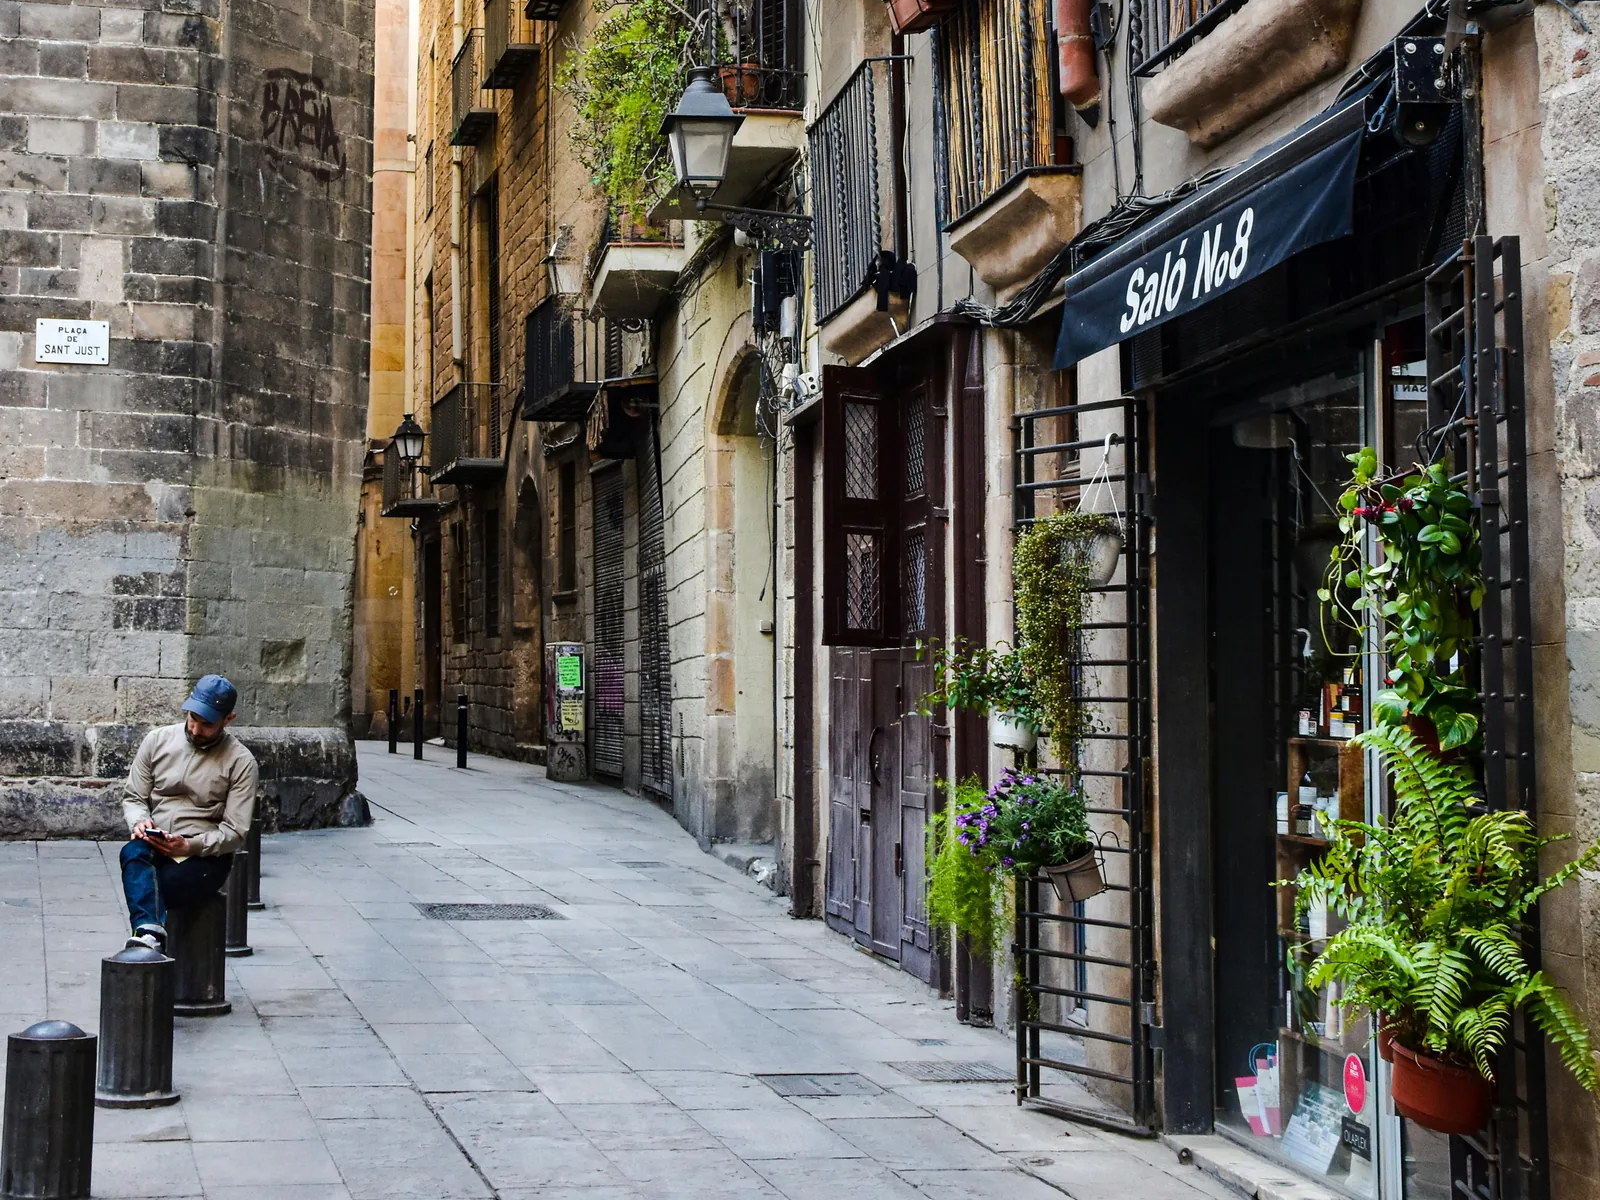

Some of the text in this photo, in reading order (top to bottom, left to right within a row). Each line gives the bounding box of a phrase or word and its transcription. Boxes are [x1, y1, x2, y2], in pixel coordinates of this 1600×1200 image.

[1120, 237, 1189, 334] Saló
[58, 326, 88, 336] PLAÇA
[67, 335, 78, 343] DE
[44, 344, 101, 356] SANT JUST
